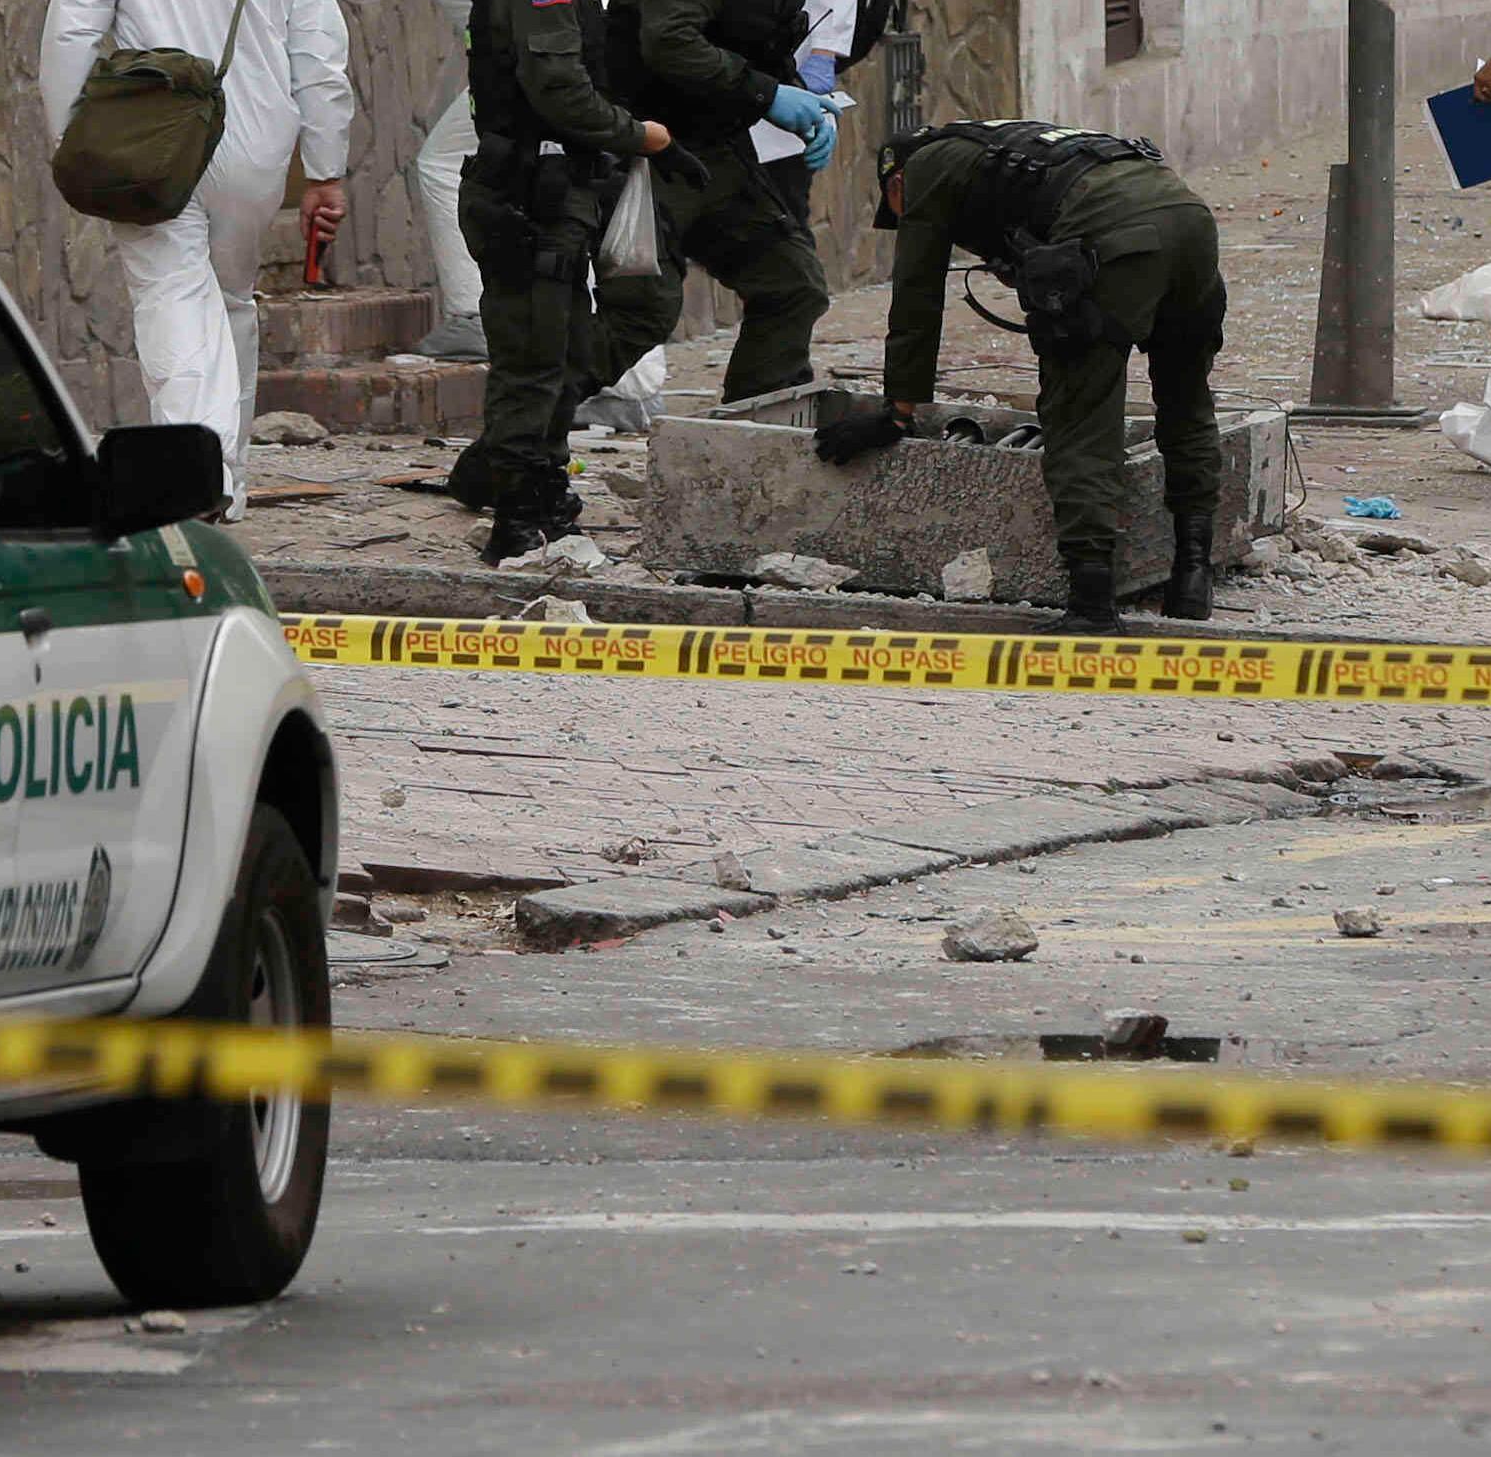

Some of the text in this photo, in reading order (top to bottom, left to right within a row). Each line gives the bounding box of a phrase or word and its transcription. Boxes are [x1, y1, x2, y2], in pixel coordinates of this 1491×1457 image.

[406, 631, 657, 660] PELIGRO NO PASE
[714, 642, 966, 670] PELIGRO NO PASE
[1024, 653, 1275, 680] PELIGRO NO PASE
[1334, 662, 1449, 687] PELIGRO
